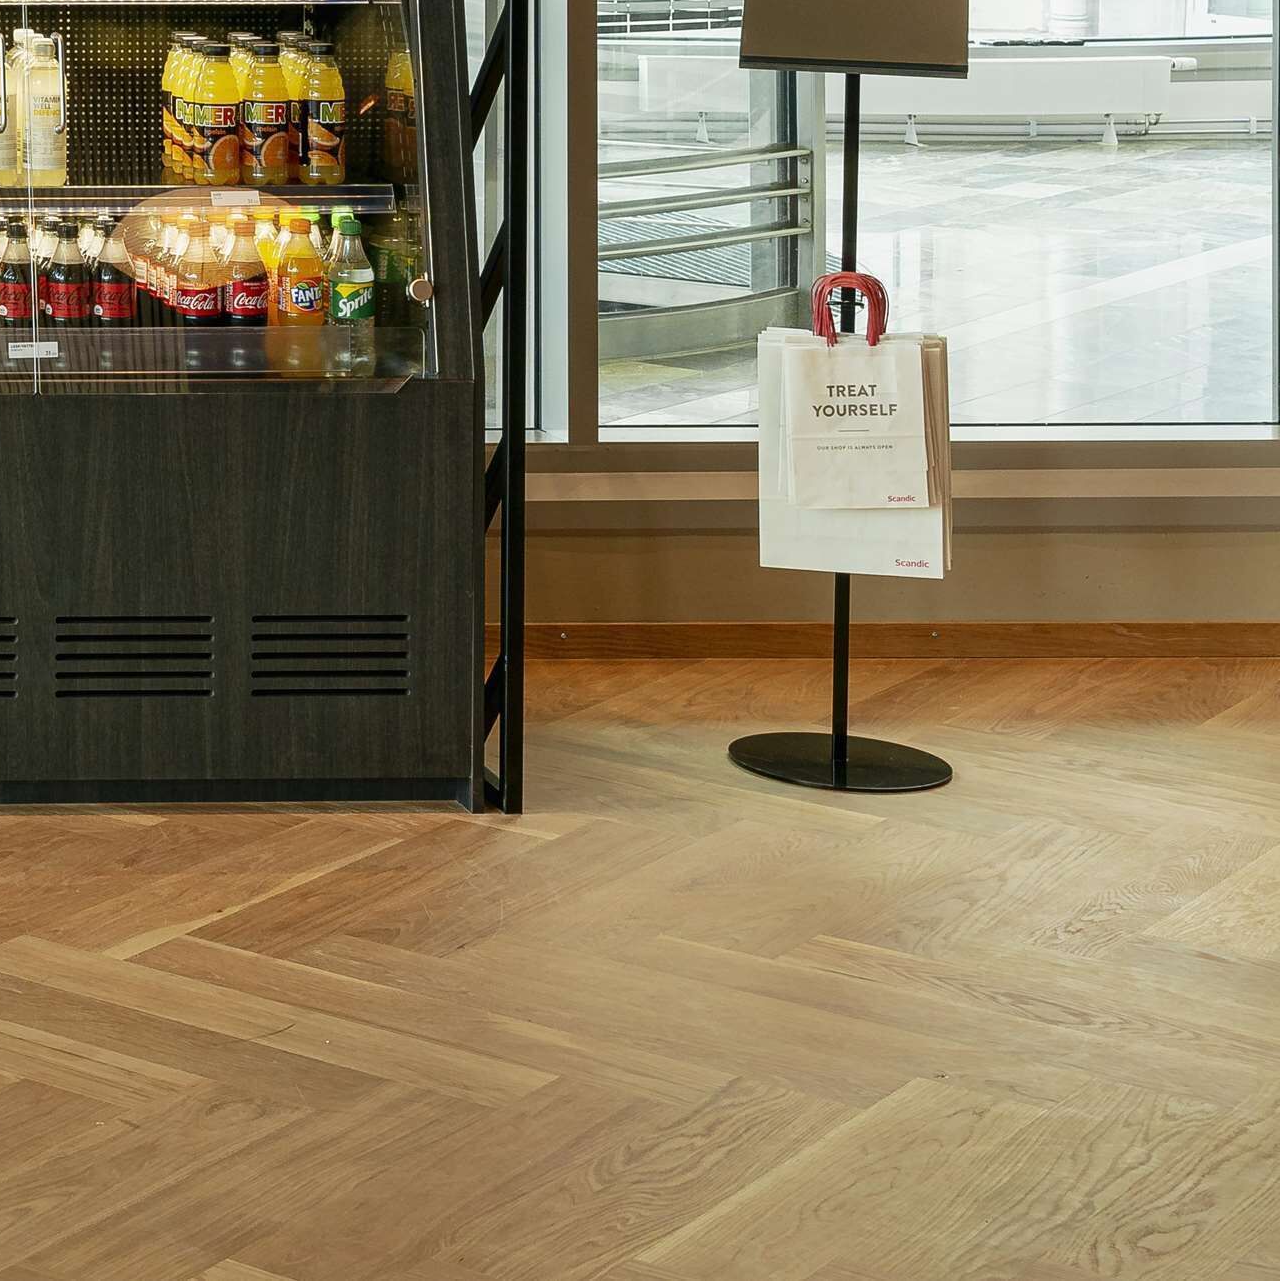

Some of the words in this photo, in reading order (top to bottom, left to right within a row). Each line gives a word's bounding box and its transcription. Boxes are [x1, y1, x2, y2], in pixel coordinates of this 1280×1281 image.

[195, 105, 236, 126] MER
[245, 102, 286, 124] MER
[320, 102, 345, 124] ME
[338, 287, 373, 317] Sprite
[826, 384, 877, 398] TREAT
[812, 404, 898, 417] YOURSELF
[895, 559, 930, 568] Scandic
